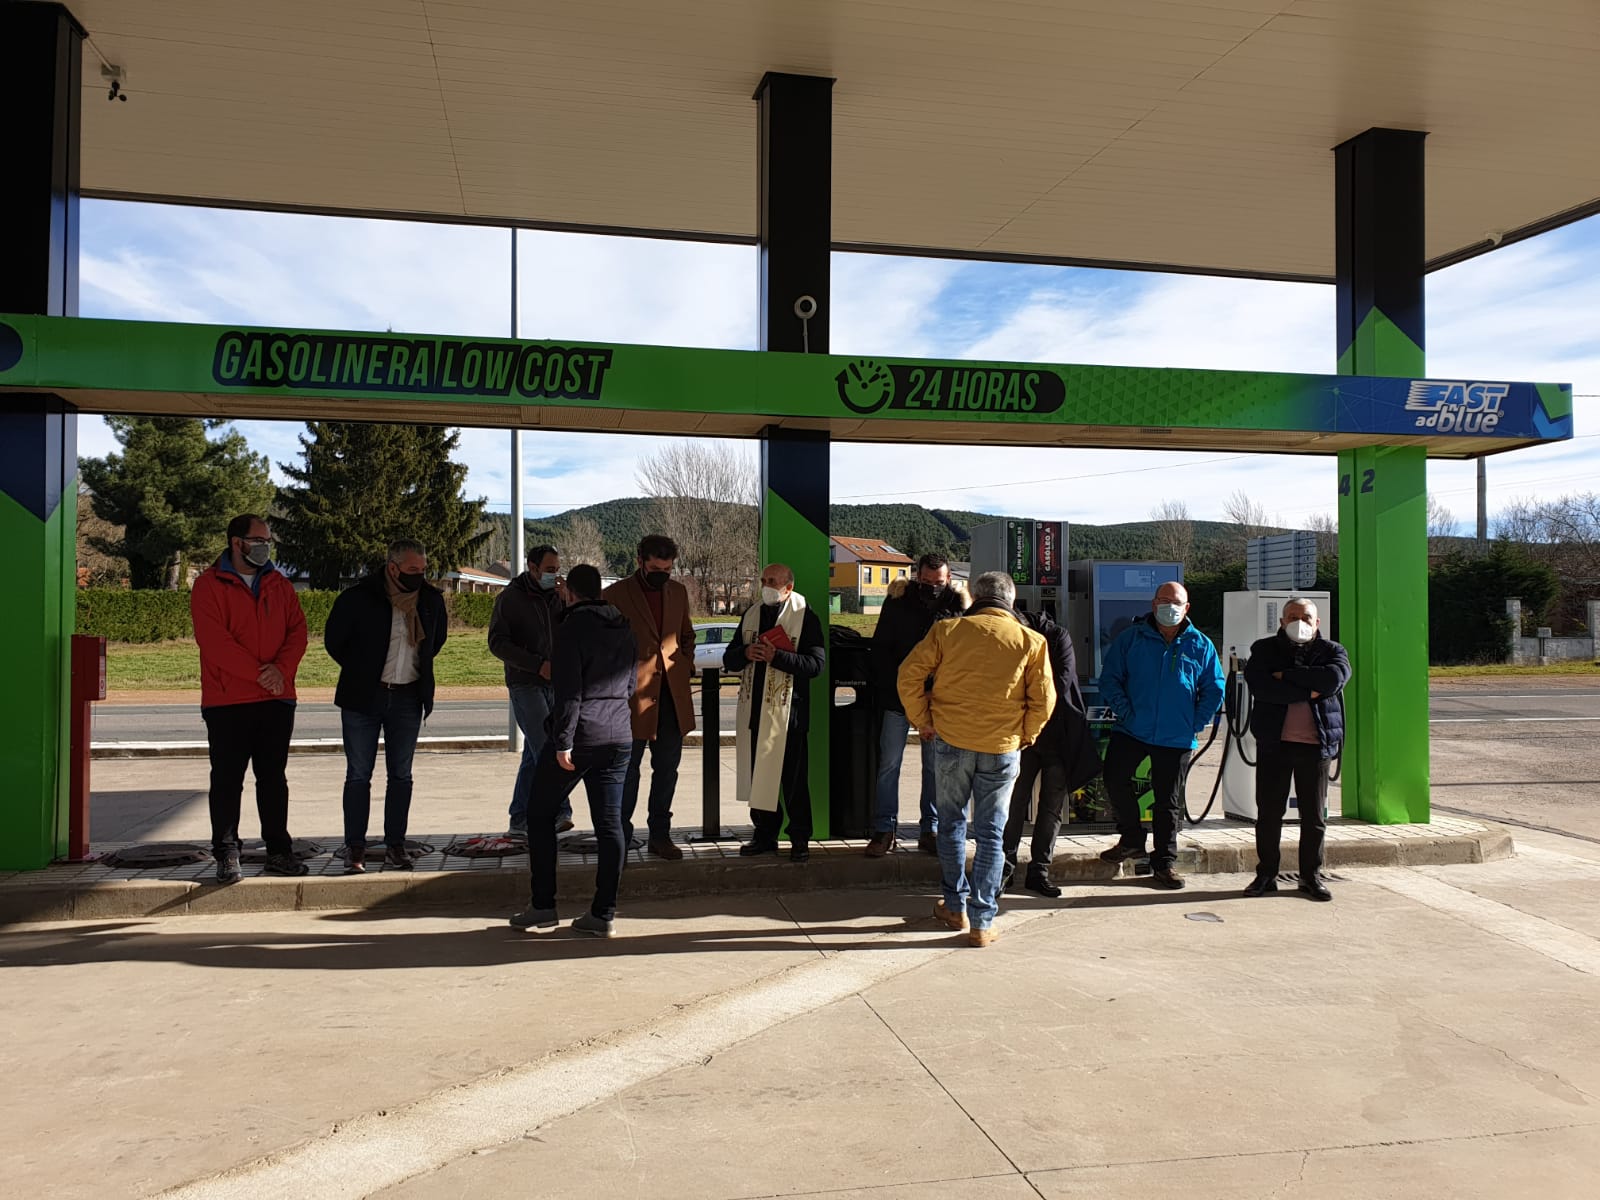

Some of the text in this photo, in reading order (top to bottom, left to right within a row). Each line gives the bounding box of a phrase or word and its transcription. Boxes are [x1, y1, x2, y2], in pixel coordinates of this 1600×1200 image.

[218, 336, 606, 395] GASOLINERA LOW COST
[905, 368, 1042, 412] 24 HORAS
[1405, 380, 1510, 413] FAST
[1415, 404, 1500, 433] adblue
[1338, 473, 1351, 497] 4
[1360, 468, 1376, 494] 2
[1013, 572, 1026, 581] 95
